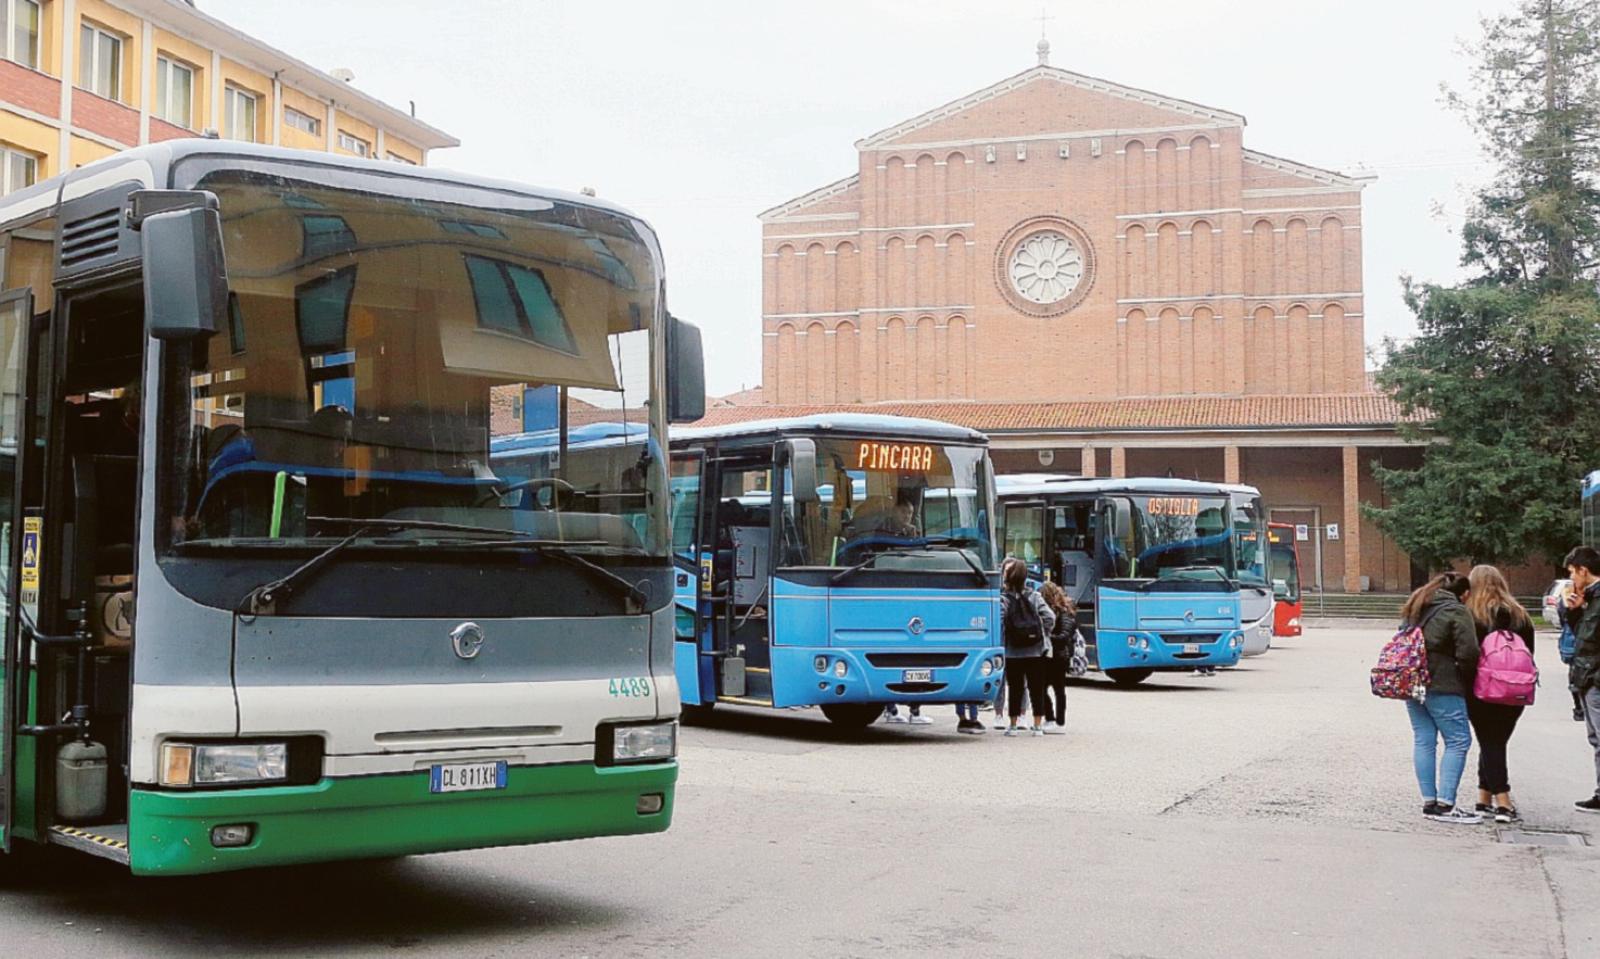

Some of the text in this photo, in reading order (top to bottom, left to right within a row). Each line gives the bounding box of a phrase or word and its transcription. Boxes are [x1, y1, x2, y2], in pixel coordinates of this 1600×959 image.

[858, 443, 932, 470] PINCARA
[1148, 497, 1198, 515] OSTIGLIA
[608, 677, 650, 698] 4489
[443, 769, 456, 786] CL
[460, 766, 496, 786] 811XH
